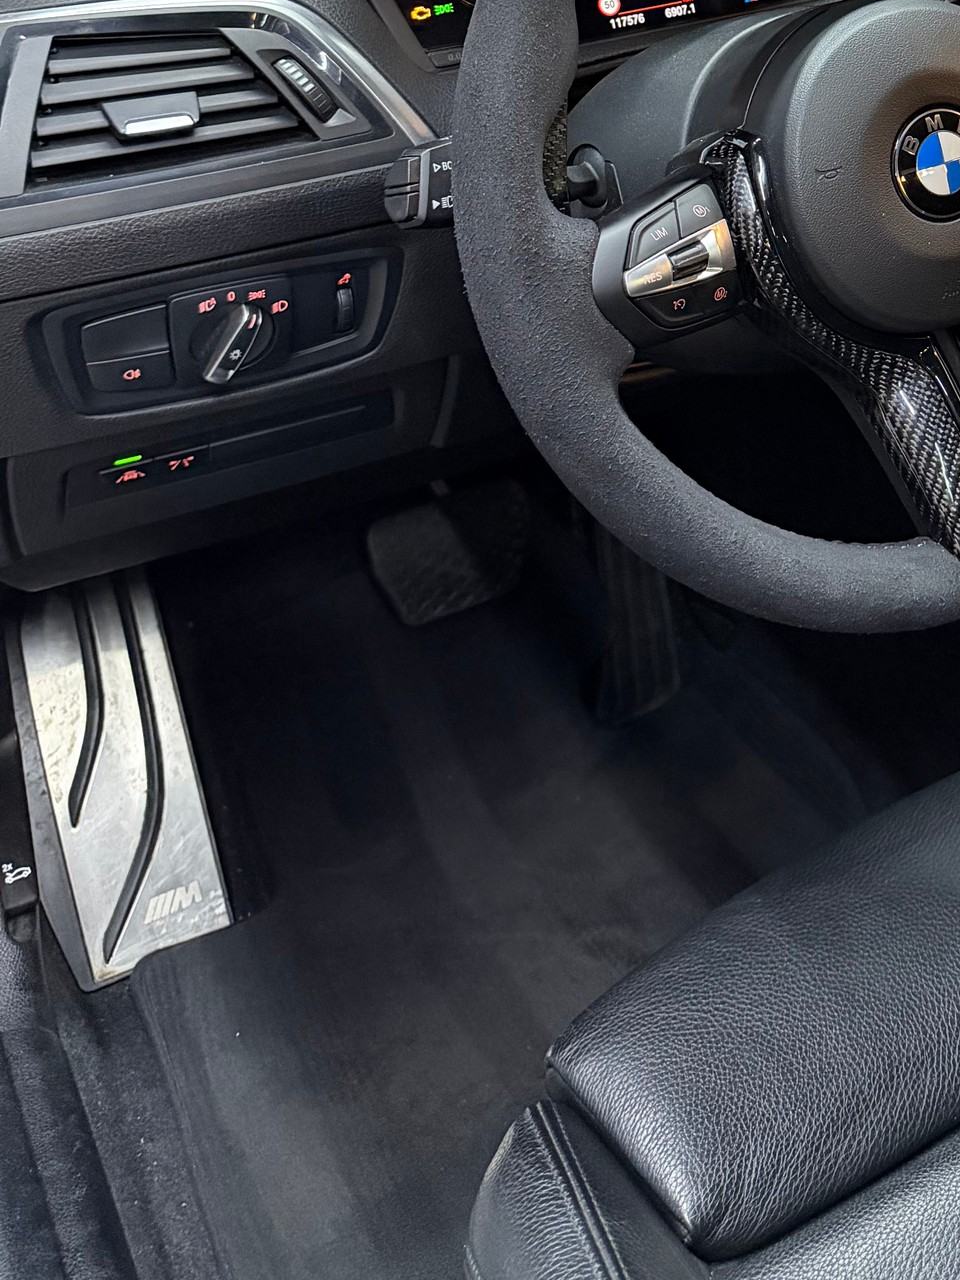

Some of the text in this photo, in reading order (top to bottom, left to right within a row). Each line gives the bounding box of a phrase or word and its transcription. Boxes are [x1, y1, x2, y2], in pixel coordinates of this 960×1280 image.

[604, 0, 615, 9] 50
[609, 3, 696, 29] 117576 6907.1
[442, 161, 453, 171] BC
[650, 226, 668, 241] LIM
[643, 271, 662, 284] RES
[2, 863, 13, 871] 2x
